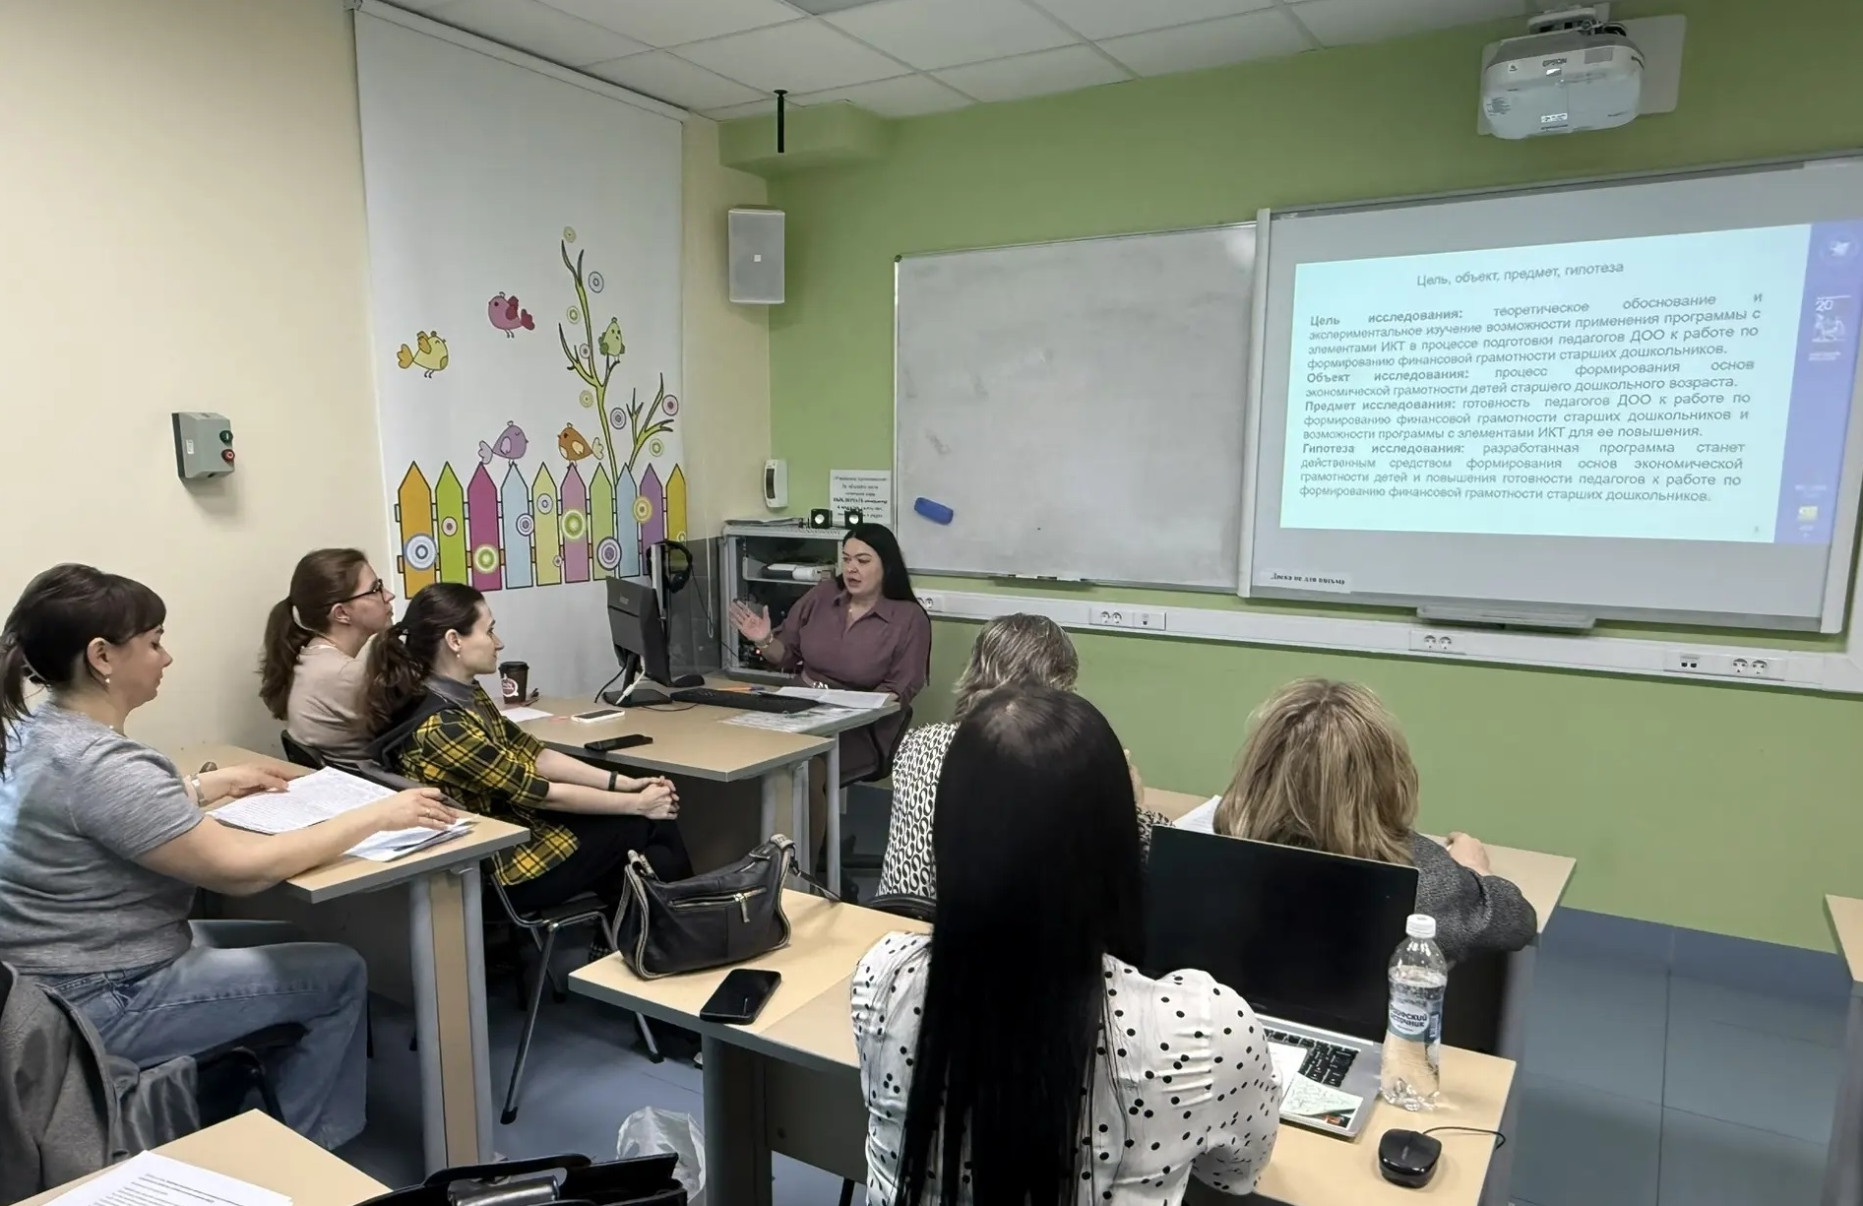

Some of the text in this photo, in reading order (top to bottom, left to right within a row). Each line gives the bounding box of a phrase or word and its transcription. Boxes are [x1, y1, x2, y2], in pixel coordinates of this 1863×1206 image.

[1542, 57, 1567, 67] EPSON
[1417, 262, 1624, 288] Цель, объект, предмет, гипотеза
[1310, 292, 1763, 327] Цель исследования: теоретическое обоснование и
[1309, 309, 1761, 342] экспериментальное изучение возможности применения программы с
[1308, 343, 1376, 355] элементами
[1381, 341, 1405, 352] ИКТ
[1422, 340, 1478, 353] процессе
[1483, 334, 1553, 349] подготовки
[1559, 332, 1625, 345] педагогов
[1630, 330, 1665, 343] ДОО
[1683, 326, 1734, 342] работе
[1741, 326, 1758, 337] по
[1307, 344, 1727, 370] формированию финансовой грамотности старших дошкольников.
[1307, 359, 1754, 383] Объект исследования: процесс формирования основ
[1305, 377, 1738, 397] экономической грамотности детей старшего дошкольного возраста.
[1305, 401, 1355, 412] Предмет
[1362, 400, 1456, 411] исследования:
[1463, 398, 1530, 409] готовность
[1545, 396, 1610, 408] педагогов
[1617, 394, 1652, 407] ДОО
[1674, 392, 1724, 407] работе
[1733, 393, 1751, 404] по
[1304, 409, 1749, 427] формированию финансовой грамотности старших дошкольников и
[1303, 426, 1703, 441] возможности программы с элементами ИКТ для ее повышения.
[1302, 442, 1745, 456] Гипотеза исследования: разработанная программа станет
[1300, 456, 1743, 471] действенным средством формирования основ экономической
[1300, 473, 1369, 484] грамотности
[1374, 471, 1407, 483] детей
[1426, 473, 1496, 483] повышения
[1502, 474, 1572, 484] готовности
[1579, 474, 1645, 486] педагогов
[1666, 473, 1715, 487] работе
[1723, 474, 1741, 486] по
[1299, 485, 1712, 503] формированию финансовой грамотности старших дошкольников.
